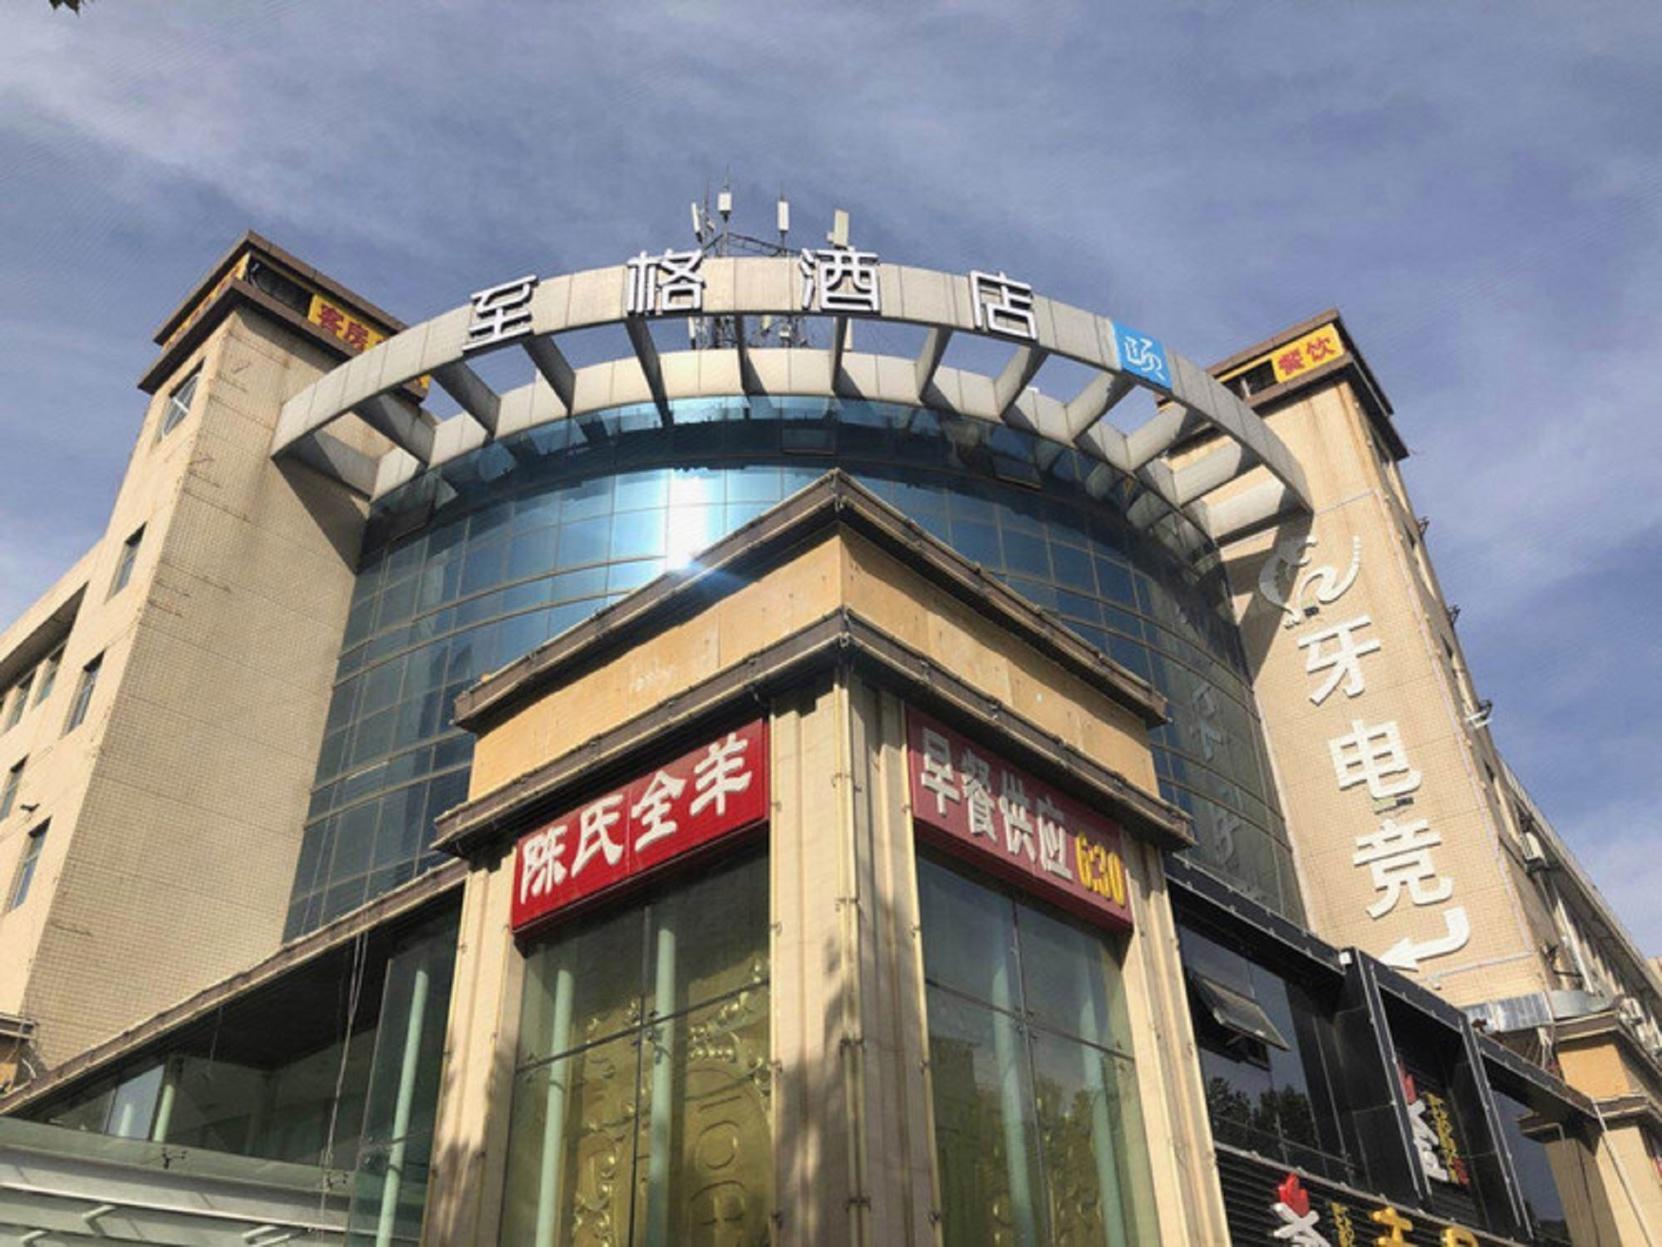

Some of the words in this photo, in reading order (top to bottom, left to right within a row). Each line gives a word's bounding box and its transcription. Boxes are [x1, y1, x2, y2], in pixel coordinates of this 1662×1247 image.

[464, 247, 1039, 350] 至格酒店
[1278, 337, 1336, 376] 餐饮
[520, 733, 752, 904] 陈氏全羊
